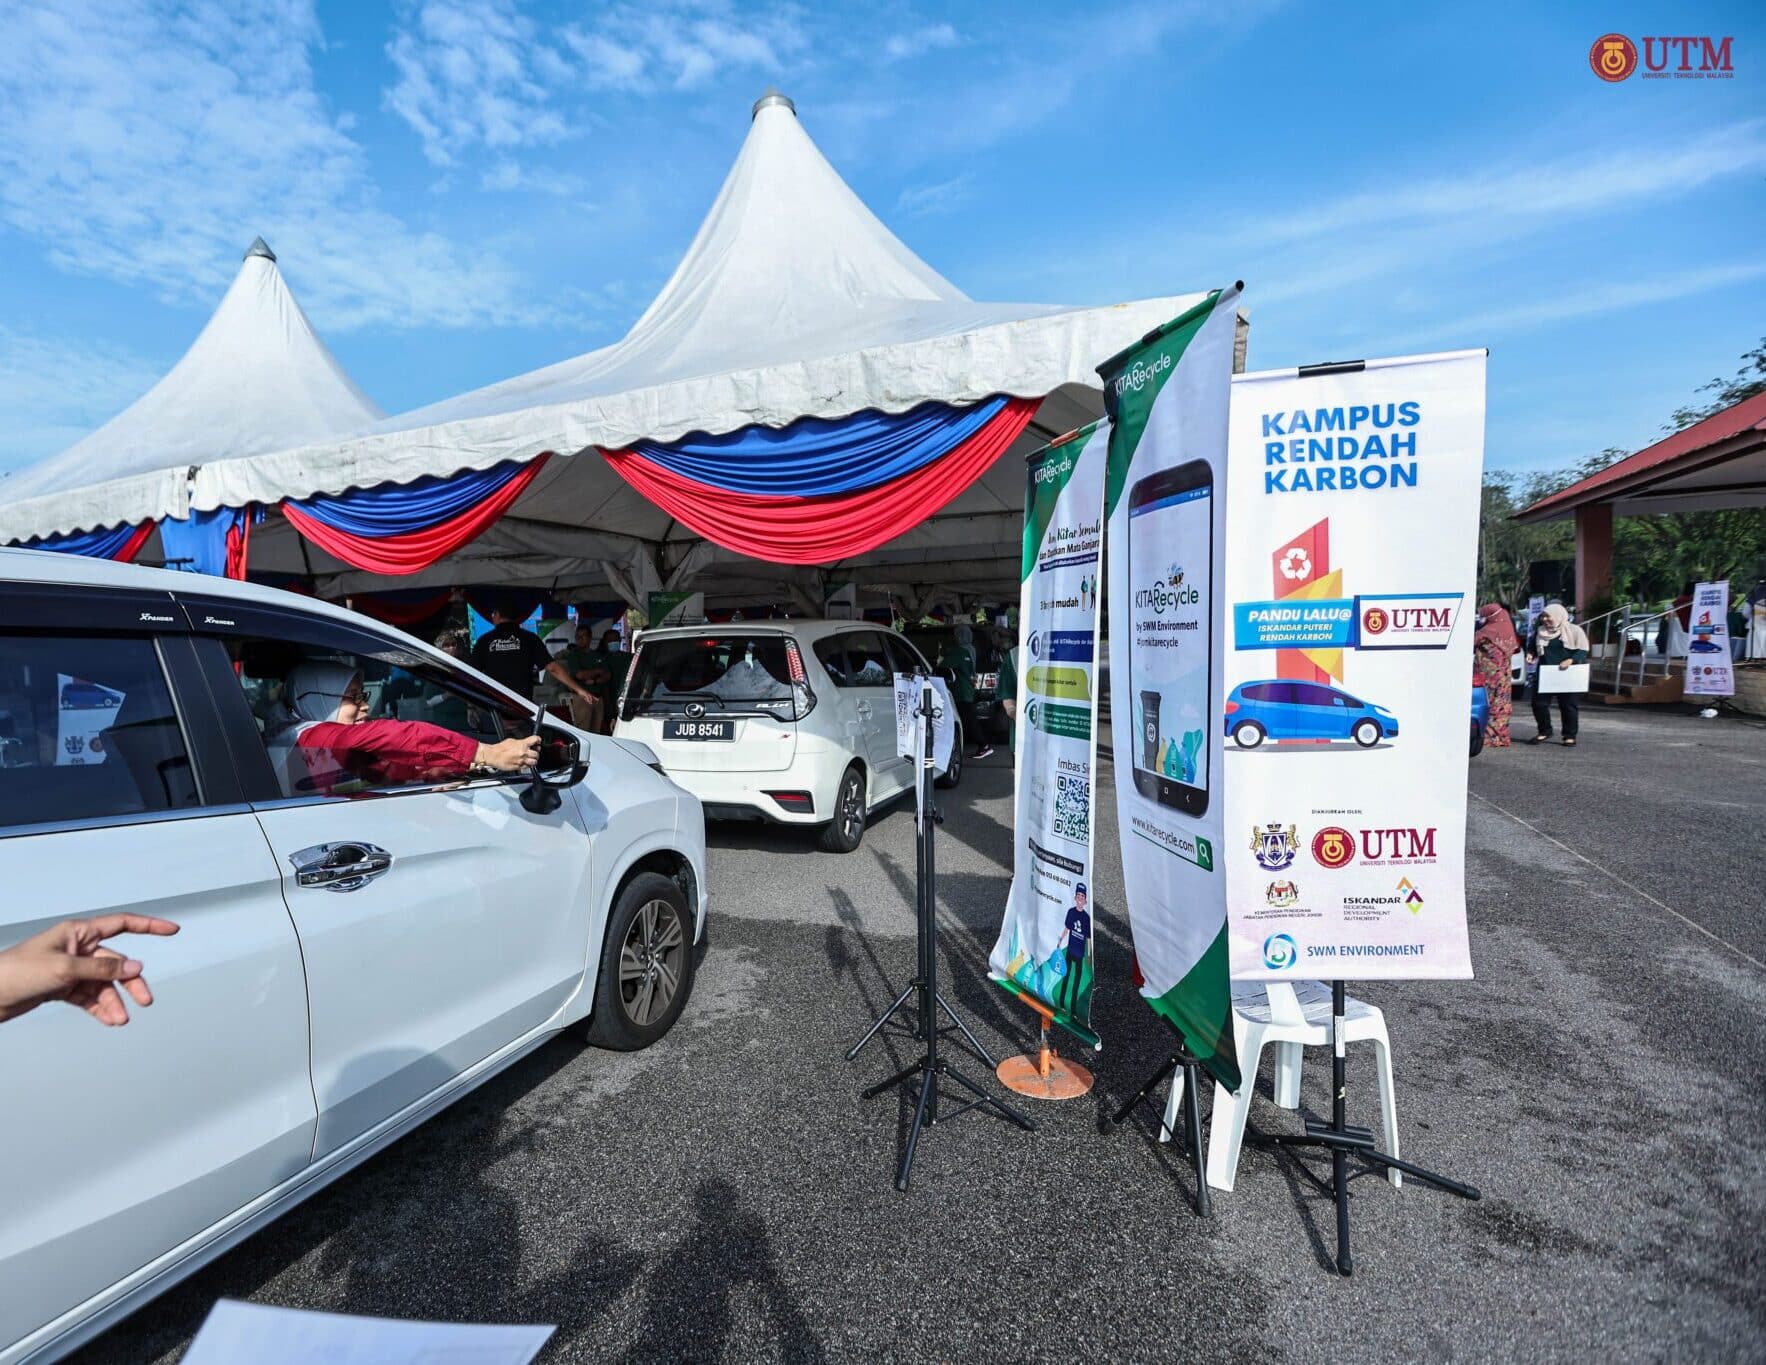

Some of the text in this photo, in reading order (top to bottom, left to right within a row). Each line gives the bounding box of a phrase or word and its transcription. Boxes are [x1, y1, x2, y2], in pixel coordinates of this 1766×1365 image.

[1115, 353, 1171, 397] KITARecycle
[1262, 401, 1421, 437] KAMPUS
[1265, 432, 1416, 465] RENDAH
[1264, 462, 1418, 494] KARBON
[1056, 597, 1079, 608] mudah
[1135, 583, 1199, 612] KITARecycle
[1248, 608, 1352, 622] PANDU LALU@
[1391, 608, 1451, 628] UTM
[1136, 619, 1198, 633] by SWM Environment
[1258, 623, 1333, 632] ISKANDAR PUTERI
[675, 724, 723, 736] JUB 8541
[1058, 758, 1080, 772] Imbas
[1132, 816, 1195, 854] www.kitarecycle.com
[1360, 828, 1437, 859] UTM
[1307, 944, 1425, 957] SWM ENVIRONMENT
